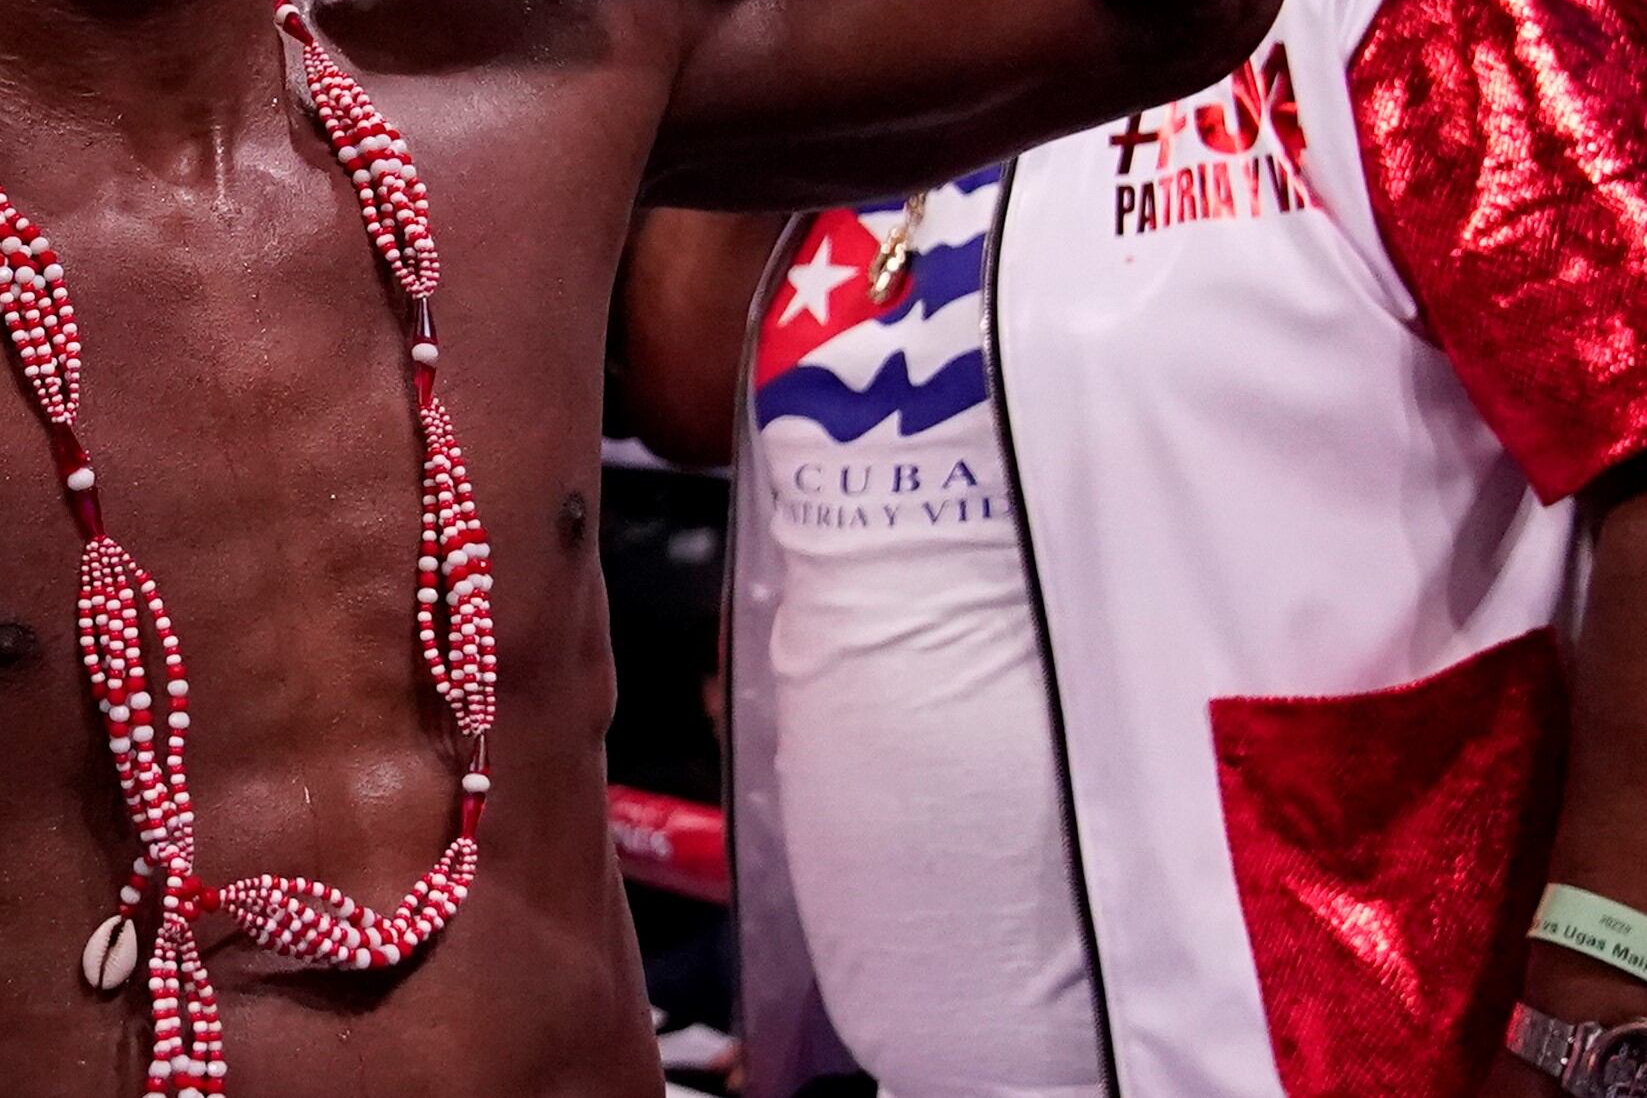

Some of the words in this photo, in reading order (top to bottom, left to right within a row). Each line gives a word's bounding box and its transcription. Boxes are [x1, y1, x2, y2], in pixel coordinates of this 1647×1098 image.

[1115, 159, 1237, 236] PATRIA
[1240, 156, 1261, 219] Y
[793, 458, 979, 495] CUBA
[883, 504, 899, 528] Y
[1563, 924, 1607, 951] Ugas
